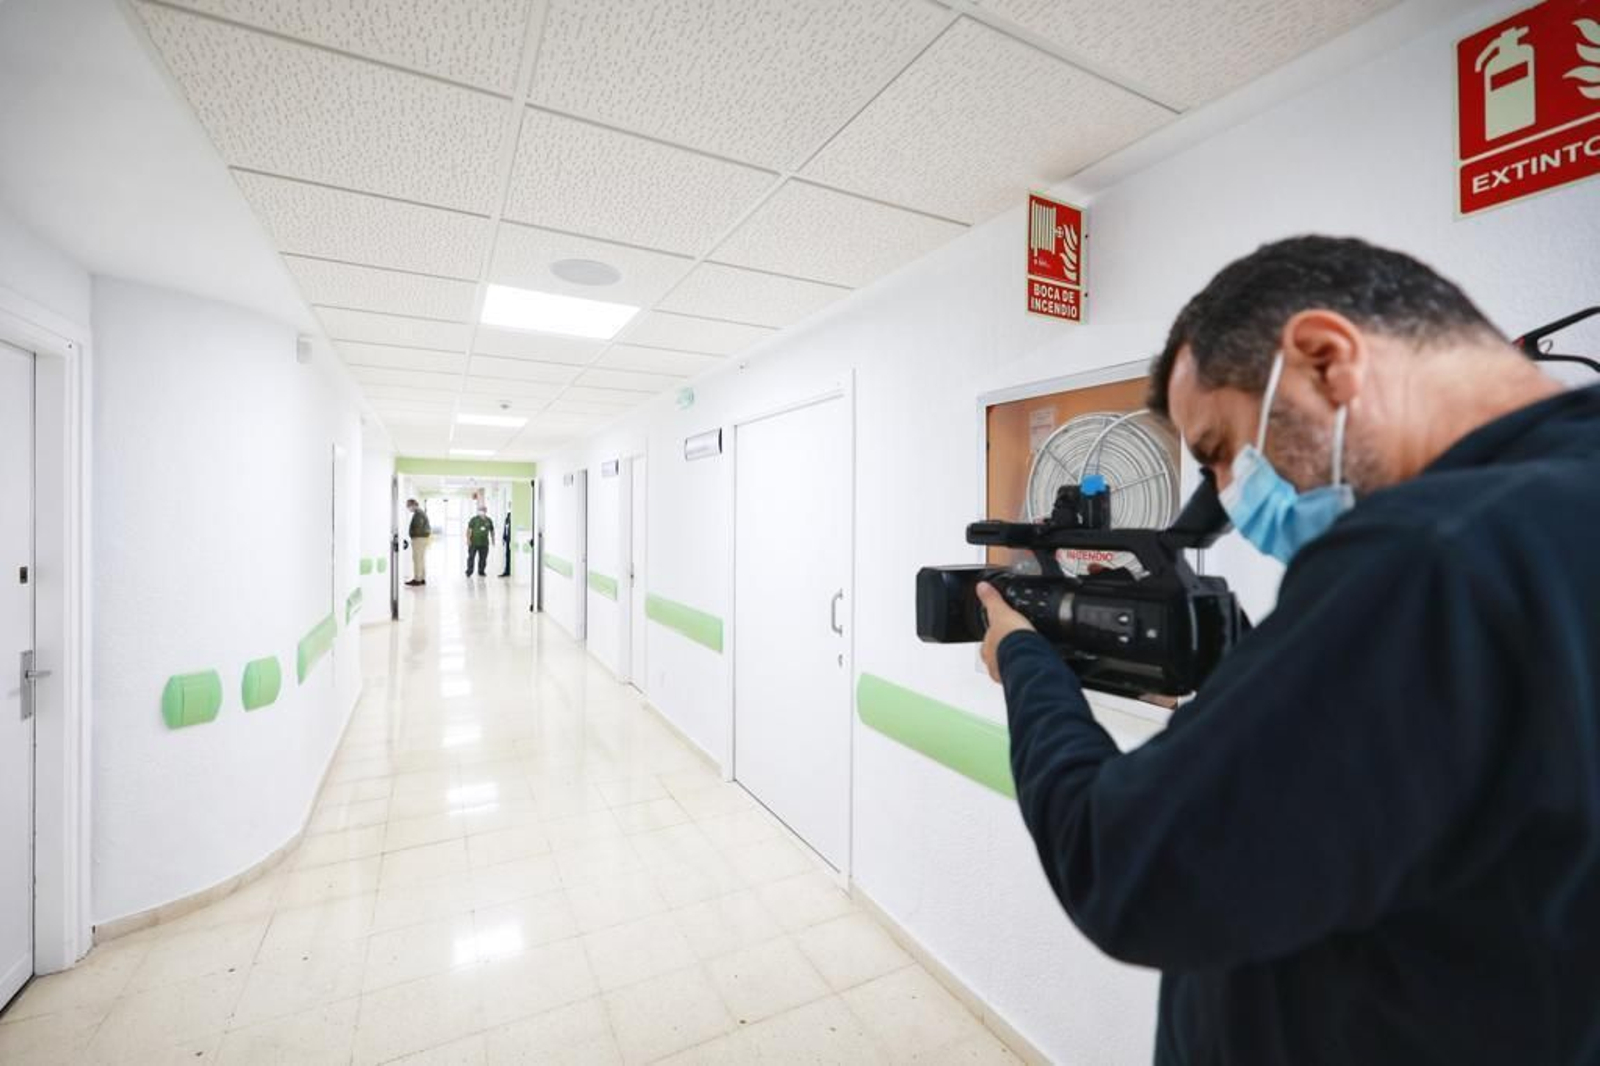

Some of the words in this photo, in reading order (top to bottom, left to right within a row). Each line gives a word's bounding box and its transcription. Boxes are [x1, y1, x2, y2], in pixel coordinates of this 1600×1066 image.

[1472, 134, 1600, 194] EXTINTO
[1033, 283, 1060, 300] BOCA
[1062, 290, 1075, 304] DE
[1031, 296, 1077, 317] INCENDIO
